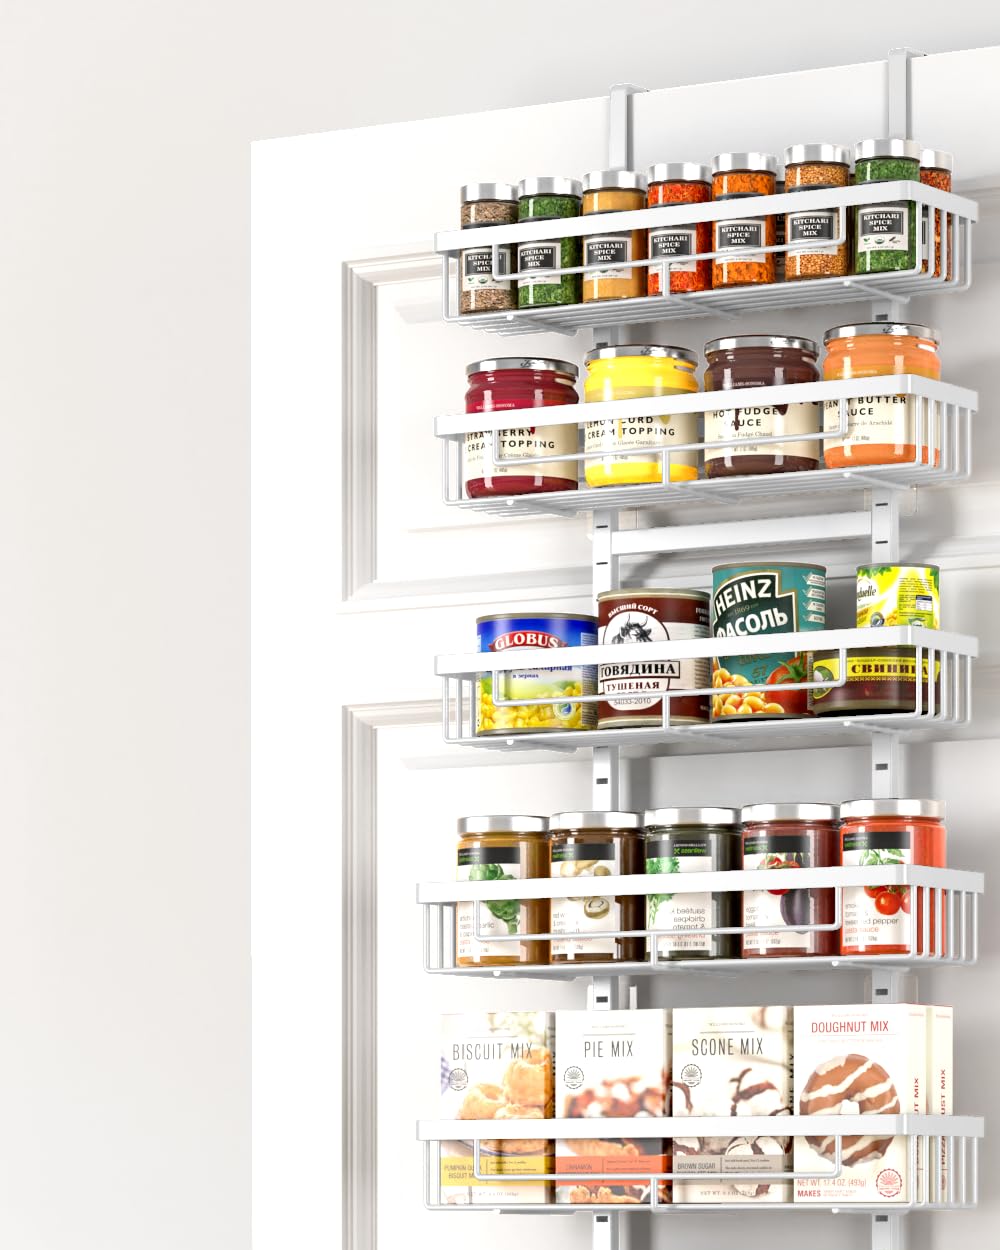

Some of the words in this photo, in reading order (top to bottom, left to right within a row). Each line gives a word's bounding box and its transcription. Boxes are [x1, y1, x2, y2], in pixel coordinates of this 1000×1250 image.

[653, 235, 688, 243] KITCHARI
[520, 248, 552, 257] KITCHARI
[524, 254, 545, 262] SPICE
[858, 396, 906, 404] BUTTER
[621, 428, 675, 436] TOPPING
[501, 440, 555, 449] TOPPING
[715, 578, 773, 613] HEINZ
[638, 604, 659, 614] СОРТ
[715, 610, 789, 638] ФАСОЛЬ
[494, 632, 560, 650] GLOBUS
[606, 681, 660, 692] ТУШЕНАЯ
[811, 1021, 867, 1033] DOUGHNUT
[870, 1021, 889, 1032] MIX
[452, 1043, 503, 1060] BISCUIT
[510, 1043, 533, 1060] MIX
[584, 1041, 603, 1058] PIE
[611, 1040, 633, 1057] MIX
[691, 1038, 734, 1056] SCONE
[740, 1037, 764, 1055] MIX
[797, 1190, 821, 1198] MAKES
